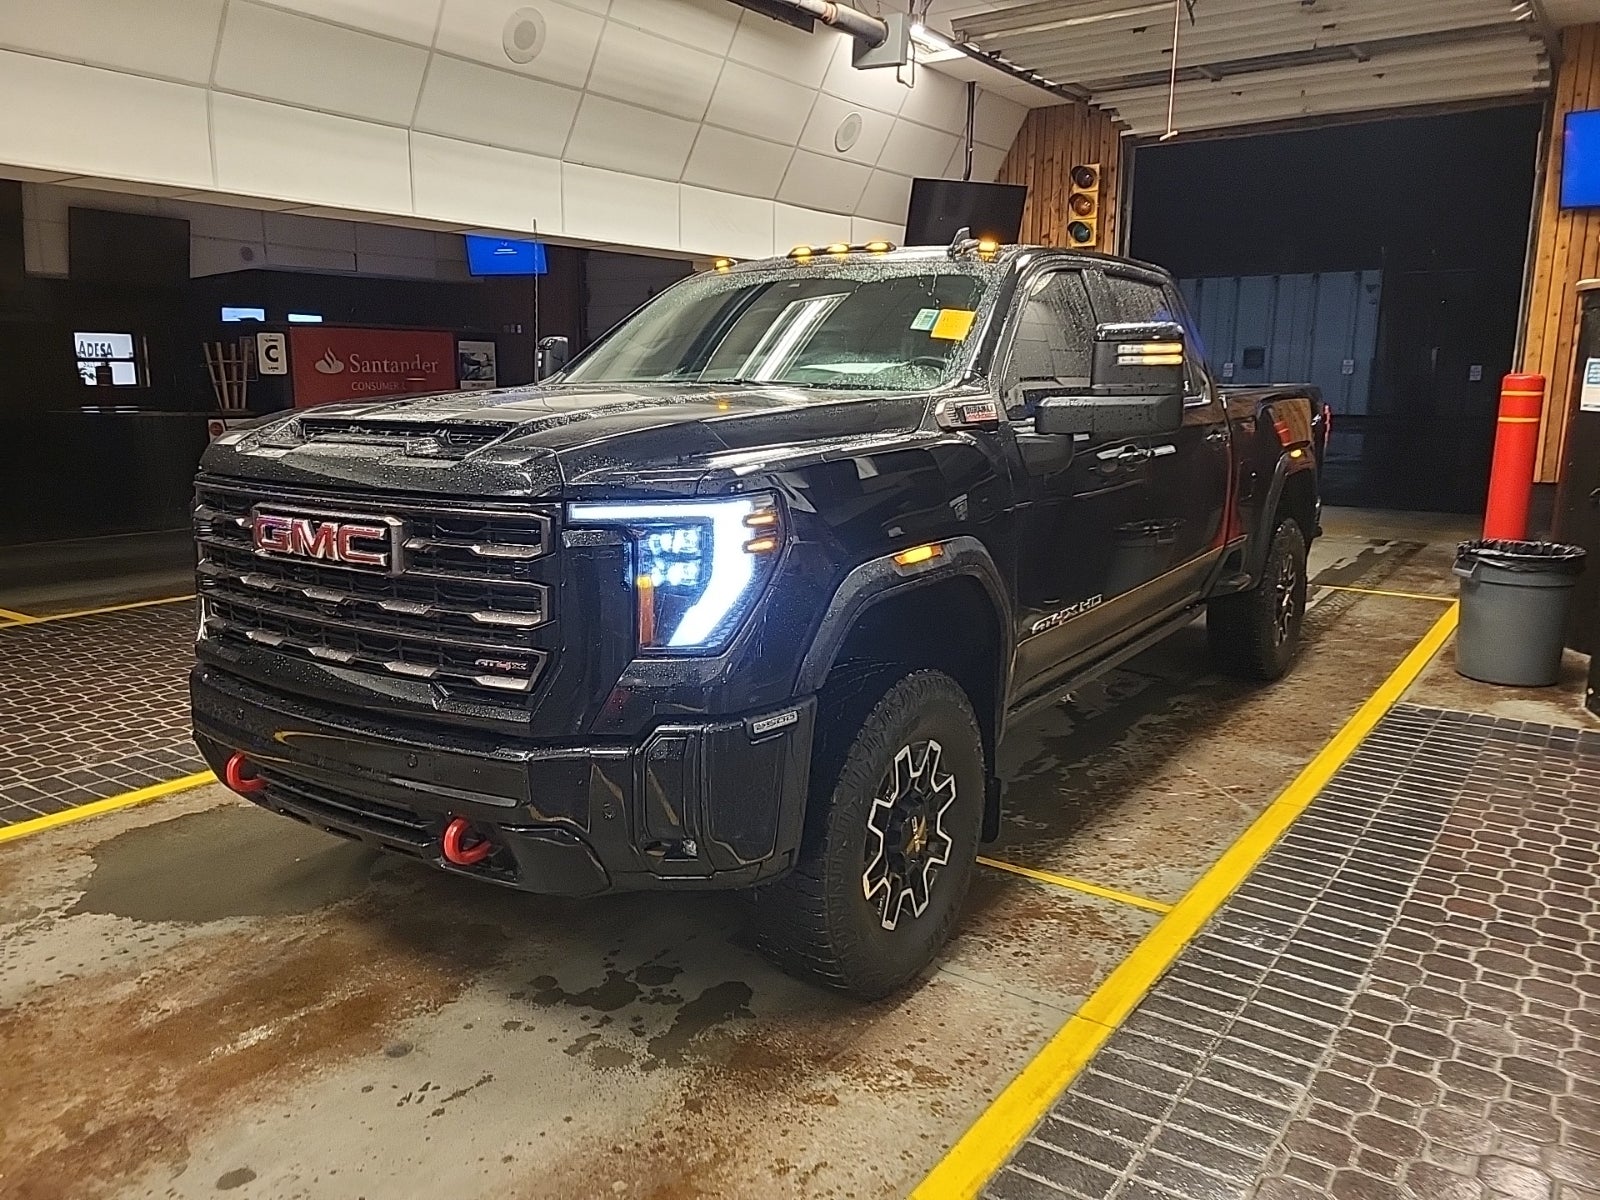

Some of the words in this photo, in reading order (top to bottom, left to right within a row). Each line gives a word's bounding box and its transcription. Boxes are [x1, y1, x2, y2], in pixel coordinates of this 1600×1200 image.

[79, 340, 114, 358] ADESA
[265, 344, 279, 363] C
[349, 353, 439, 373] Santander
[351, 381, 400, 391] CONSUMER
[255, 514, 388, 567] GMC
